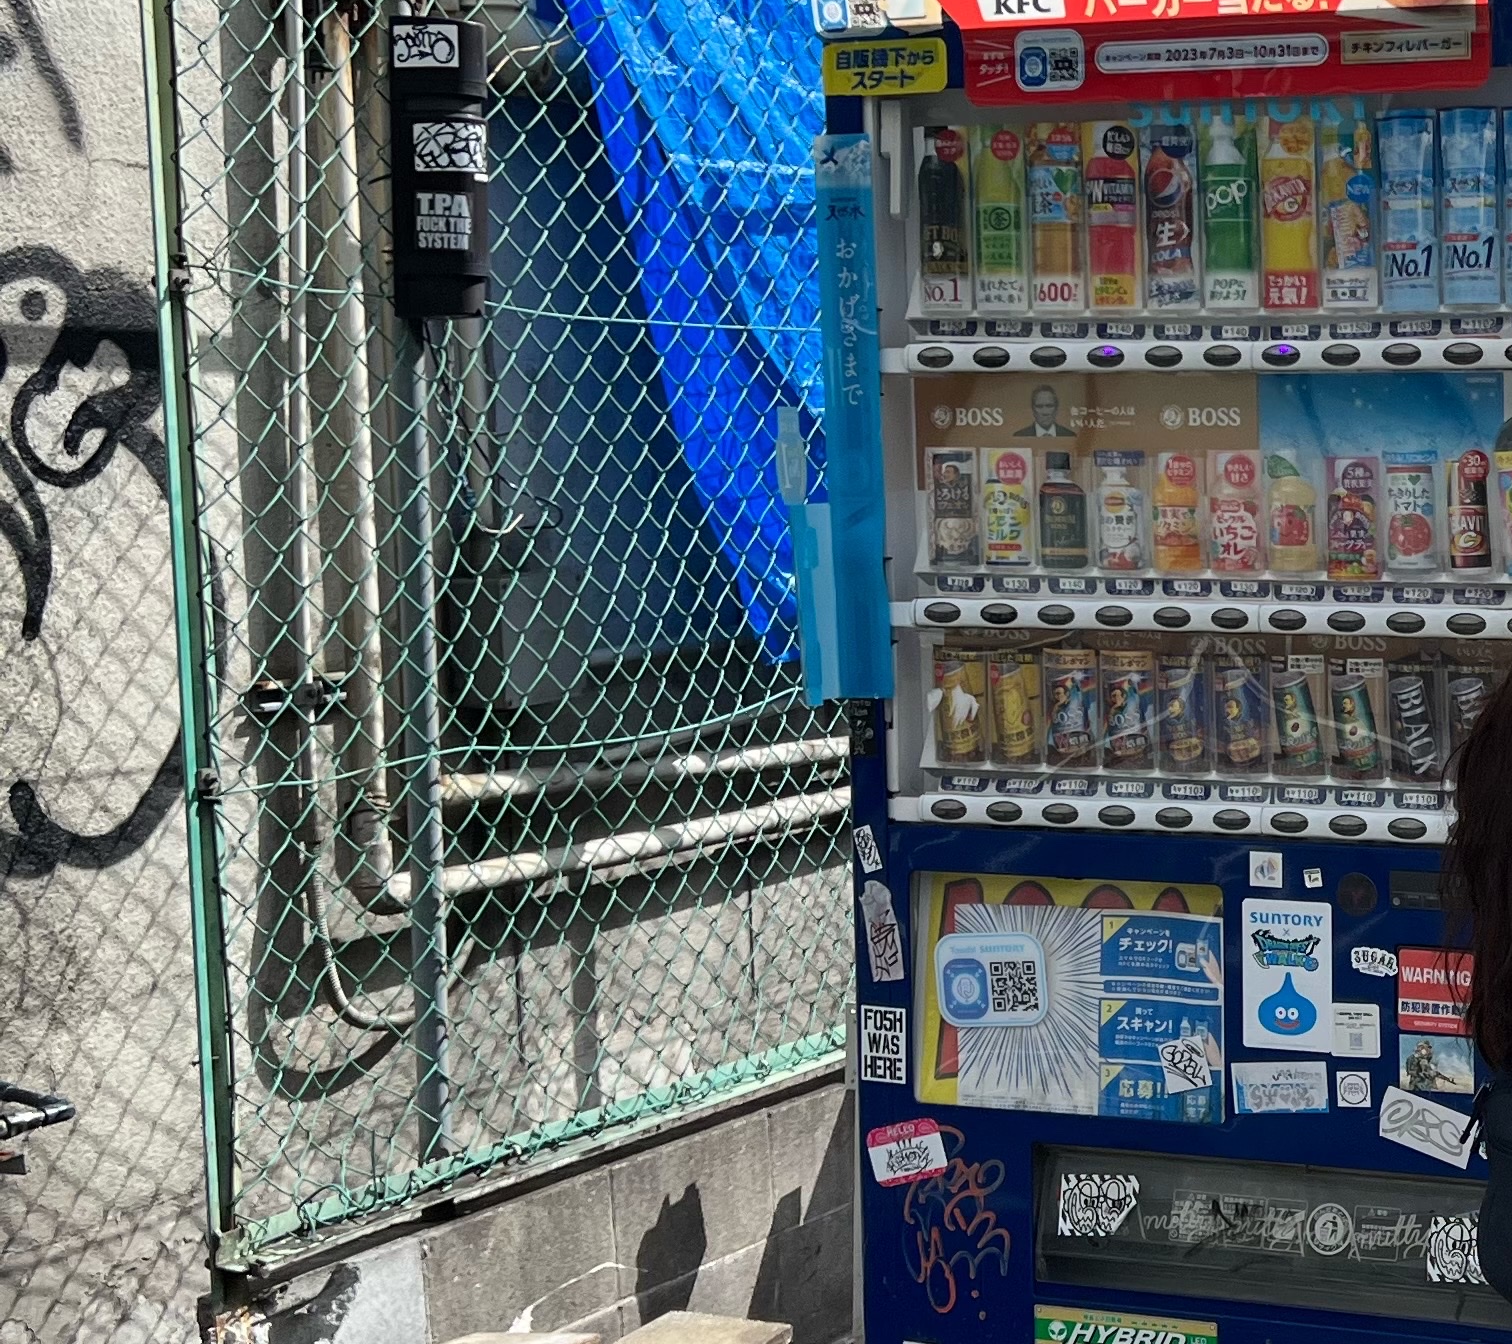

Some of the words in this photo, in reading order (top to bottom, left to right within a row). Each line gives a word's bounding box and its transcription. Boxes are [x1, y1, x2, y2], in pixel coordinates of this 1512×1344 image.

[1350, 34, 1463, 54] チキンフィレバーガー
[836, 47, 934, 70] 自販機下から
[851, 70, 915, 90] スタート
[416, 216, 447, 233] FUCK
[448, 217, 472, 233] THE
[417, 232, 469, 250] SYSTEM
[1390, 244, 1433, 278] No.1
[1452, 235, 1495, 270] No.1
[956, 407, 1004, 427] BOSS
[1187, 407, 1241, 427] BOSS
[1394, 500, 1421, 512] トマト
[1213, 525, 1257, 541] いちご
[1220, 543, 1245, 556] オレ
[1396, 689, 1440, 775] BLACK
[1249, 911, 1323, 927] SUNTORY
[1119, 937, 1173, 953] チェック!
[1402, 966, 1472, 986] WARNING
[1117, 1016, 1173, 1034] スキャン!
[868, 1032, 900, 1055] WAS
[864, 1055, 903, 1081] HERE
[887, 1123, 915, 1138] HELLO
